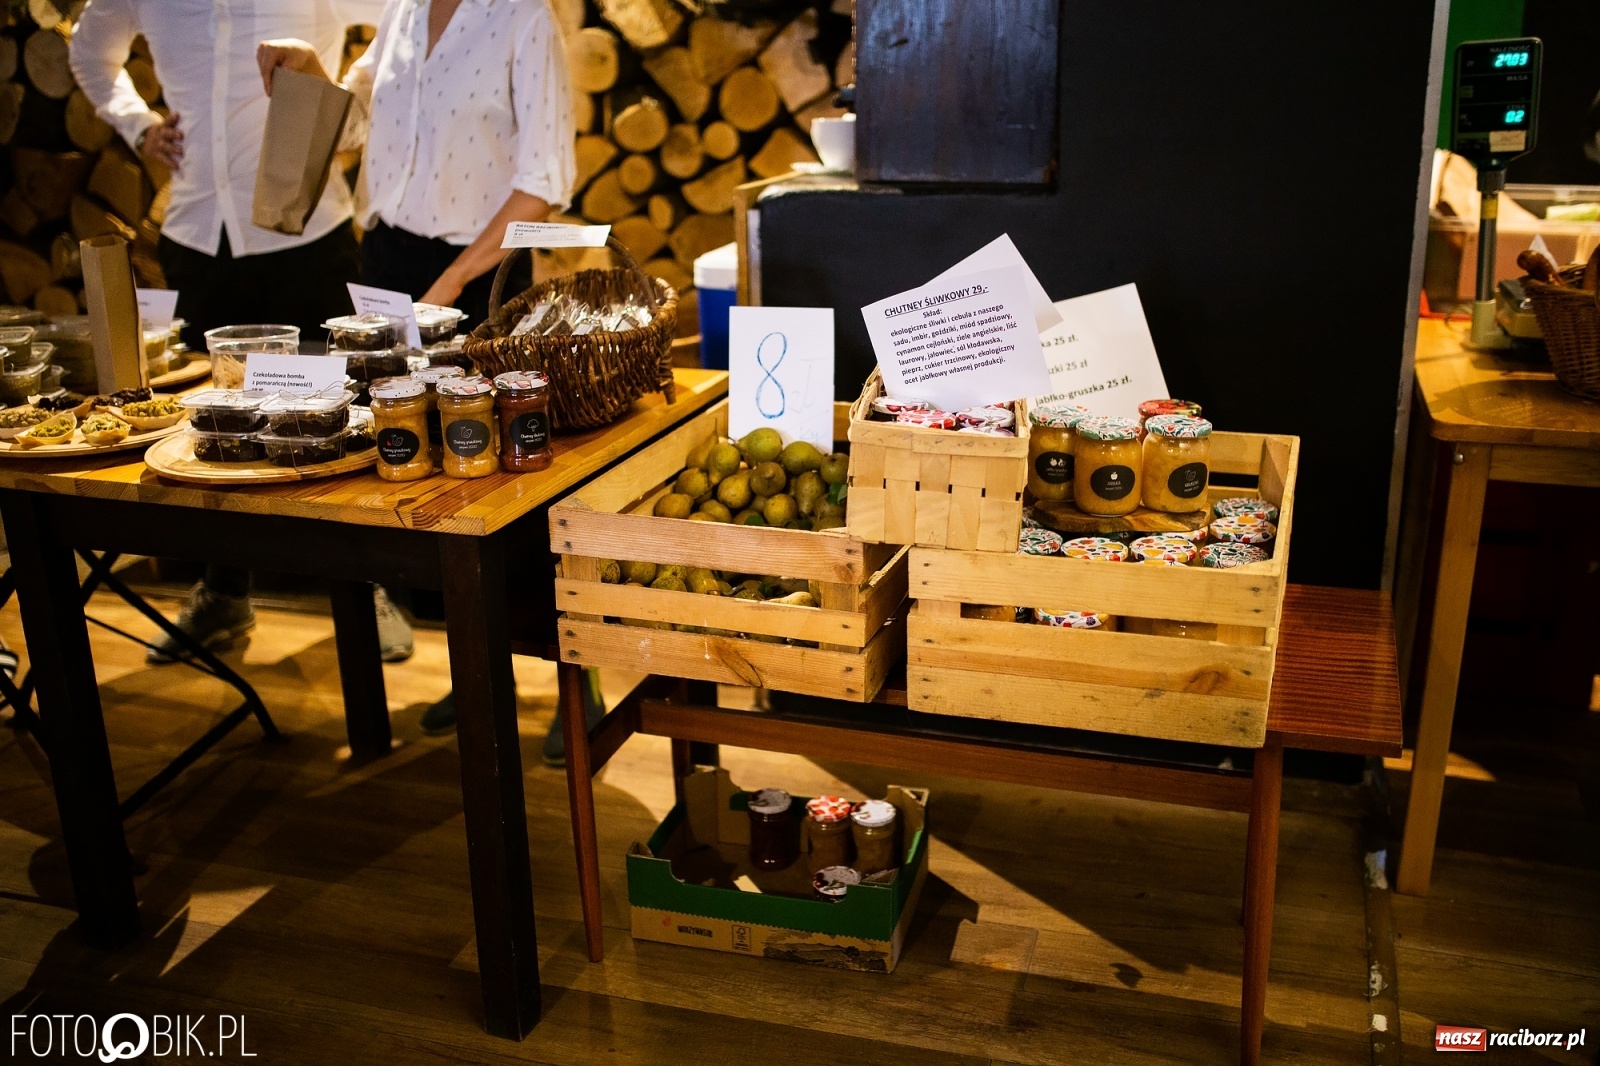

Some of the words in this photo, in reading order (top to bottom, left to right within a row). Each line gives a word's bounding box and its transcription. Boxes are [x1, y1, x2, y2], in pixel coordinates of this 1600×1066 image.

[884, 300, 923, 317] CHUTNEY
[924, 288, 970, 307] ŚLIWKOWY
[922, 308, 943, 318] Skład:
[890, 323, 928, 337] ekologiczne
[928, 316, 947, 327] śliwki
[951, 311, 972, 322] cebula
[977, 304, 1004, 315] naszego
[893, 338, 911, 346] sadu,
[911, 333, 930, 341] imbir,
[959, 320, 976, 330] miód
[976, 313, 1013, 326] spadziowy,
[896, 345, 925, 356] cynamon
[956, 333, 971, 341] ziele
[972, 325, 1006, 337] angielskie,
[898, 355, 927, 366] laurowy,
[956, 343, 966, 352] sól
[966, 336, 1003, 349] kłodawska,
[1054, 336, 1065, 346] 25
[901, 366, 923, 376] pieprz,
[924, 360, 943, 370] cukier
[944, 353, 977, 365] trzcinowy,
[977, 344, 1015, 357] ekologiczny
[904, 376, 919, 385] ocet
[918, 369, 948, 383] jabłkowy
[948, 363, 974, 374] własnej
[973, 356, 1006, 369] produkcji.
[1066, 361, 1077, 371] 25
[256, 380, 286, 388] pomarańczą
[755, 331, 787, 419] 8
[1107, 379, 1118, 389] 25
